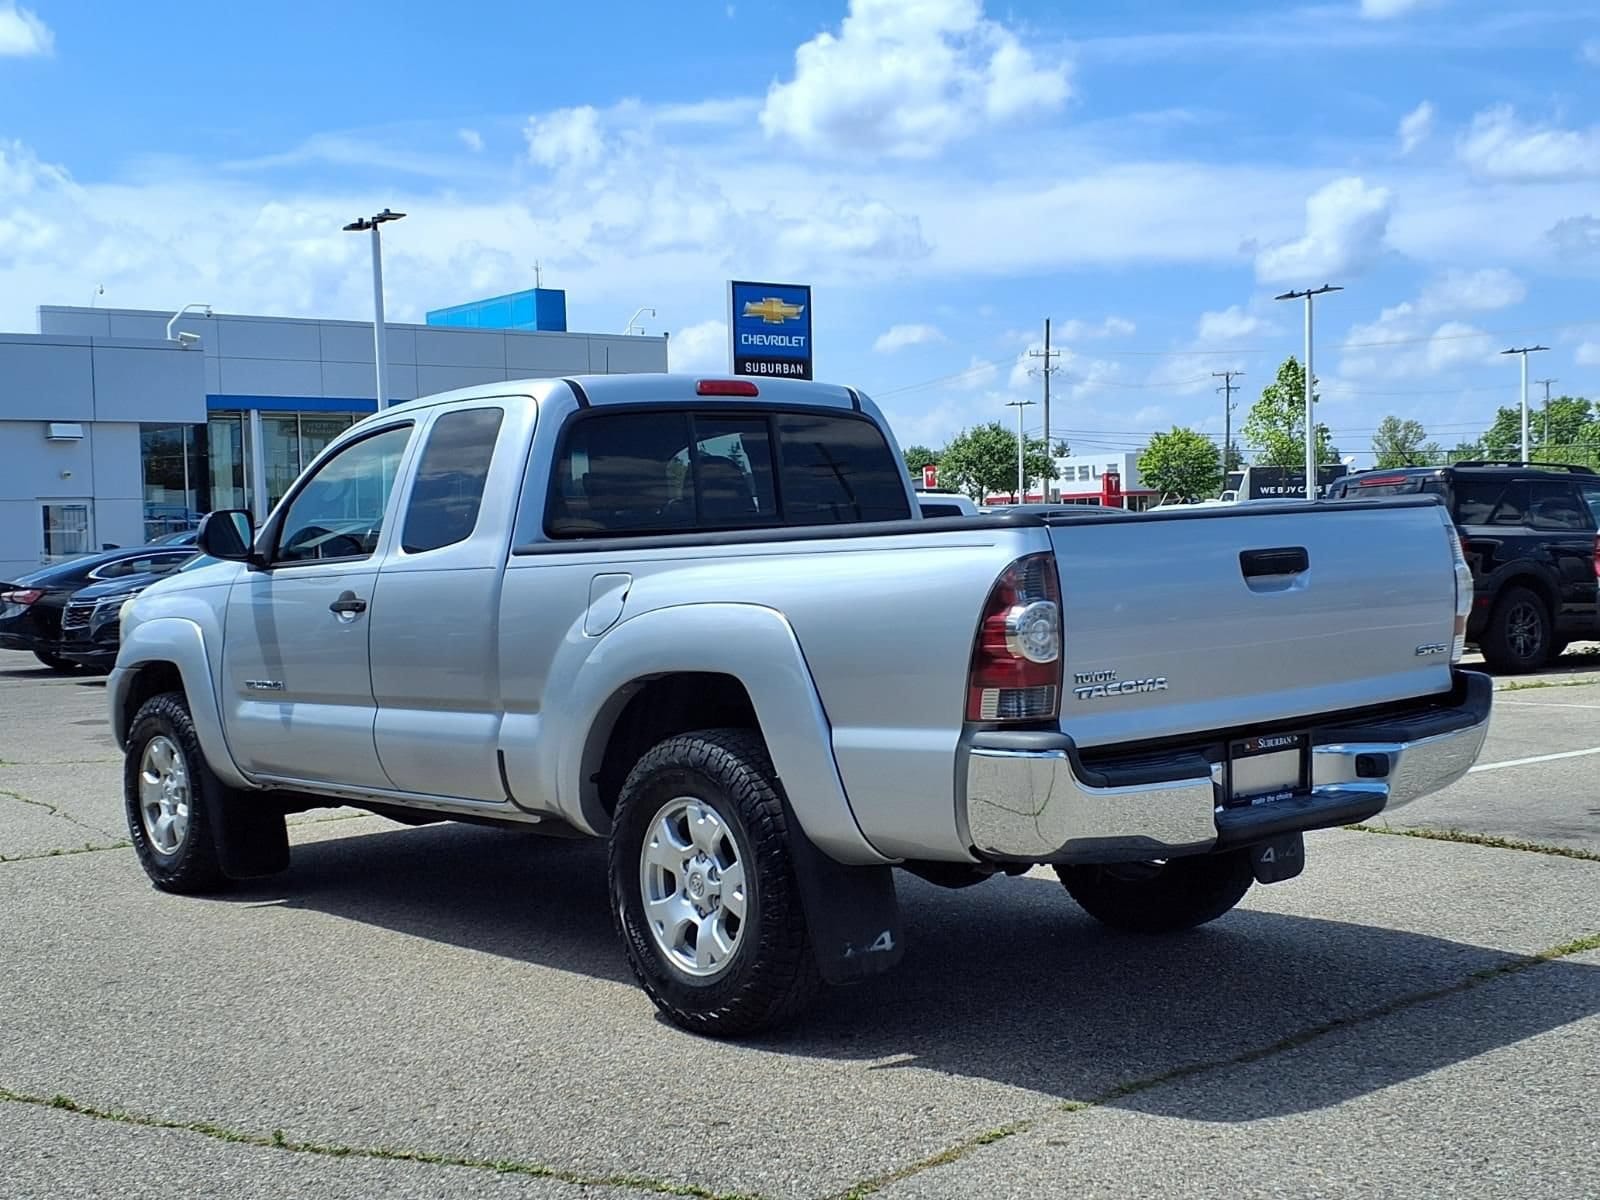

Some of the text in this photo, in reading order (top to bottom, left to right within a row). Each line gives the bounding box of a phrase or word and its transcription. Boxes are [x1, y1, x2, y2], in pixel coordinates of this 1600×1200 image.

[741, 333, 806, 347] CHEVROLET
[745, 362, 804, 374] SUBURBAN
[1055, 463, 1118, 481] ESLA
[1260, 486, 1276, 494] WE
[1297, 485, 1323, 493] CS
[1075, 670, 1117, 684] TOYOTA
[1073, 677, 1168, 699] TACOMA
